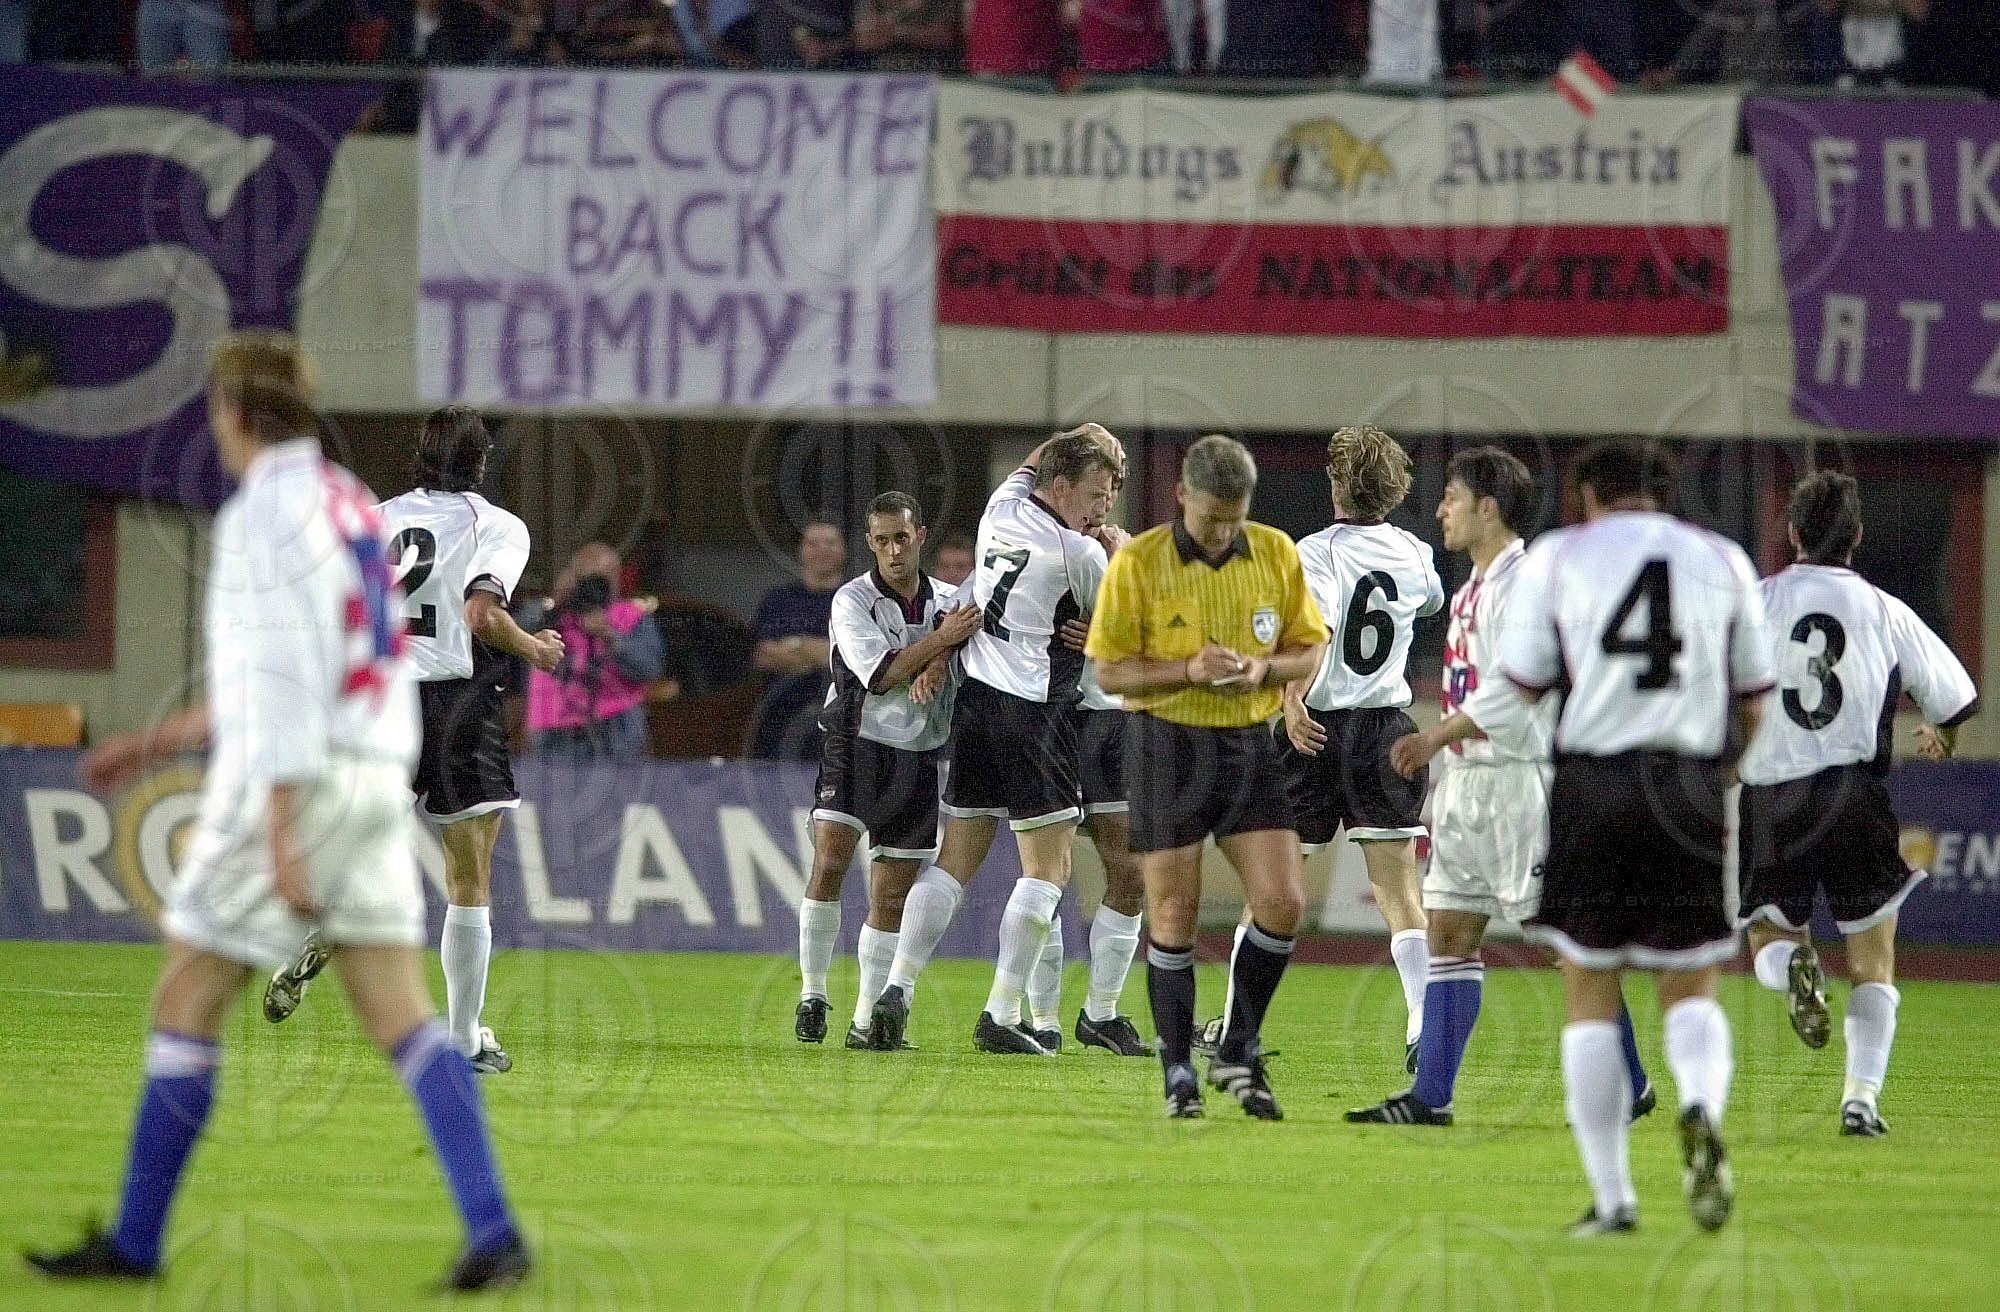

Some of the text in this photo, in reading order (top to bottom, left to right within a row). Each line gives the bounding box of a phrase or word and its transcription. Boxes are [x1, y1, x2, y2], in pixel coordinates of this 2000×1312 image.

[424, 76, 930, 178] WELCOME
[958, 117, 1681, 206] Bulldogs Austria
[565, 194, 786, 276] BACK
[1256, 253, 1713, 301] NATIONALTEAM
[385, 527, 437, 639] 2
[983, 548, 1031, 633] 7
[1343, 570, 1399, 677] 6
[1601, 559, 1682, 690] 4
[1781, 612, 1846, 731] 3
